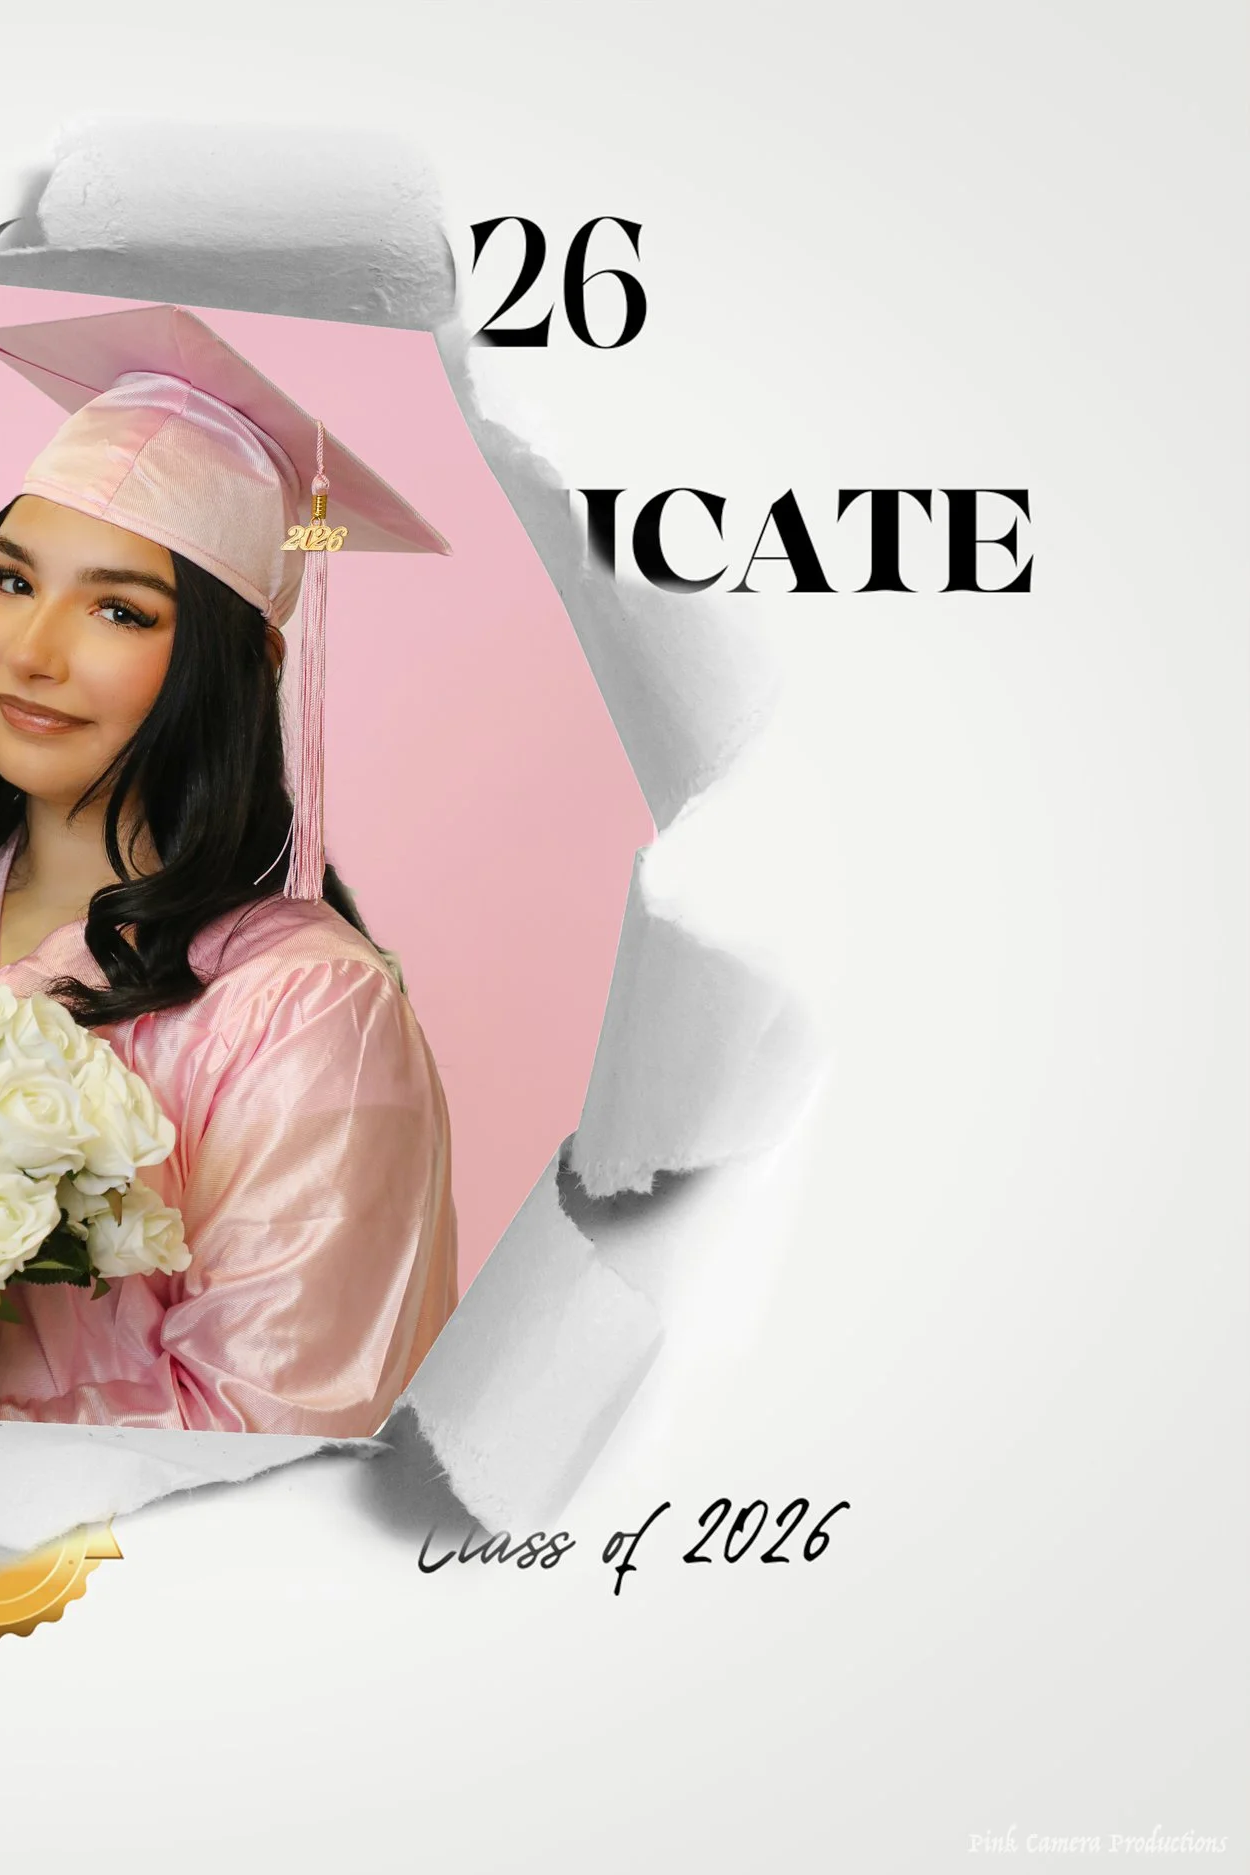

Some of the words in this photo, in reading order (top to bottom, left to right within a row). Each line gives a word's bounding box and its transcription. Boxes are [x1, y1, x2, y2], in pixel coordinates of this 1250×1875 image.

[442, 215, 648, 349] 26
[280, 524, 349, 552] 2026
[550, 487, 1034, 595] ICATE
[602, 1501, 671, 1596] of
[682, 1497, 851, 1564] 2026
